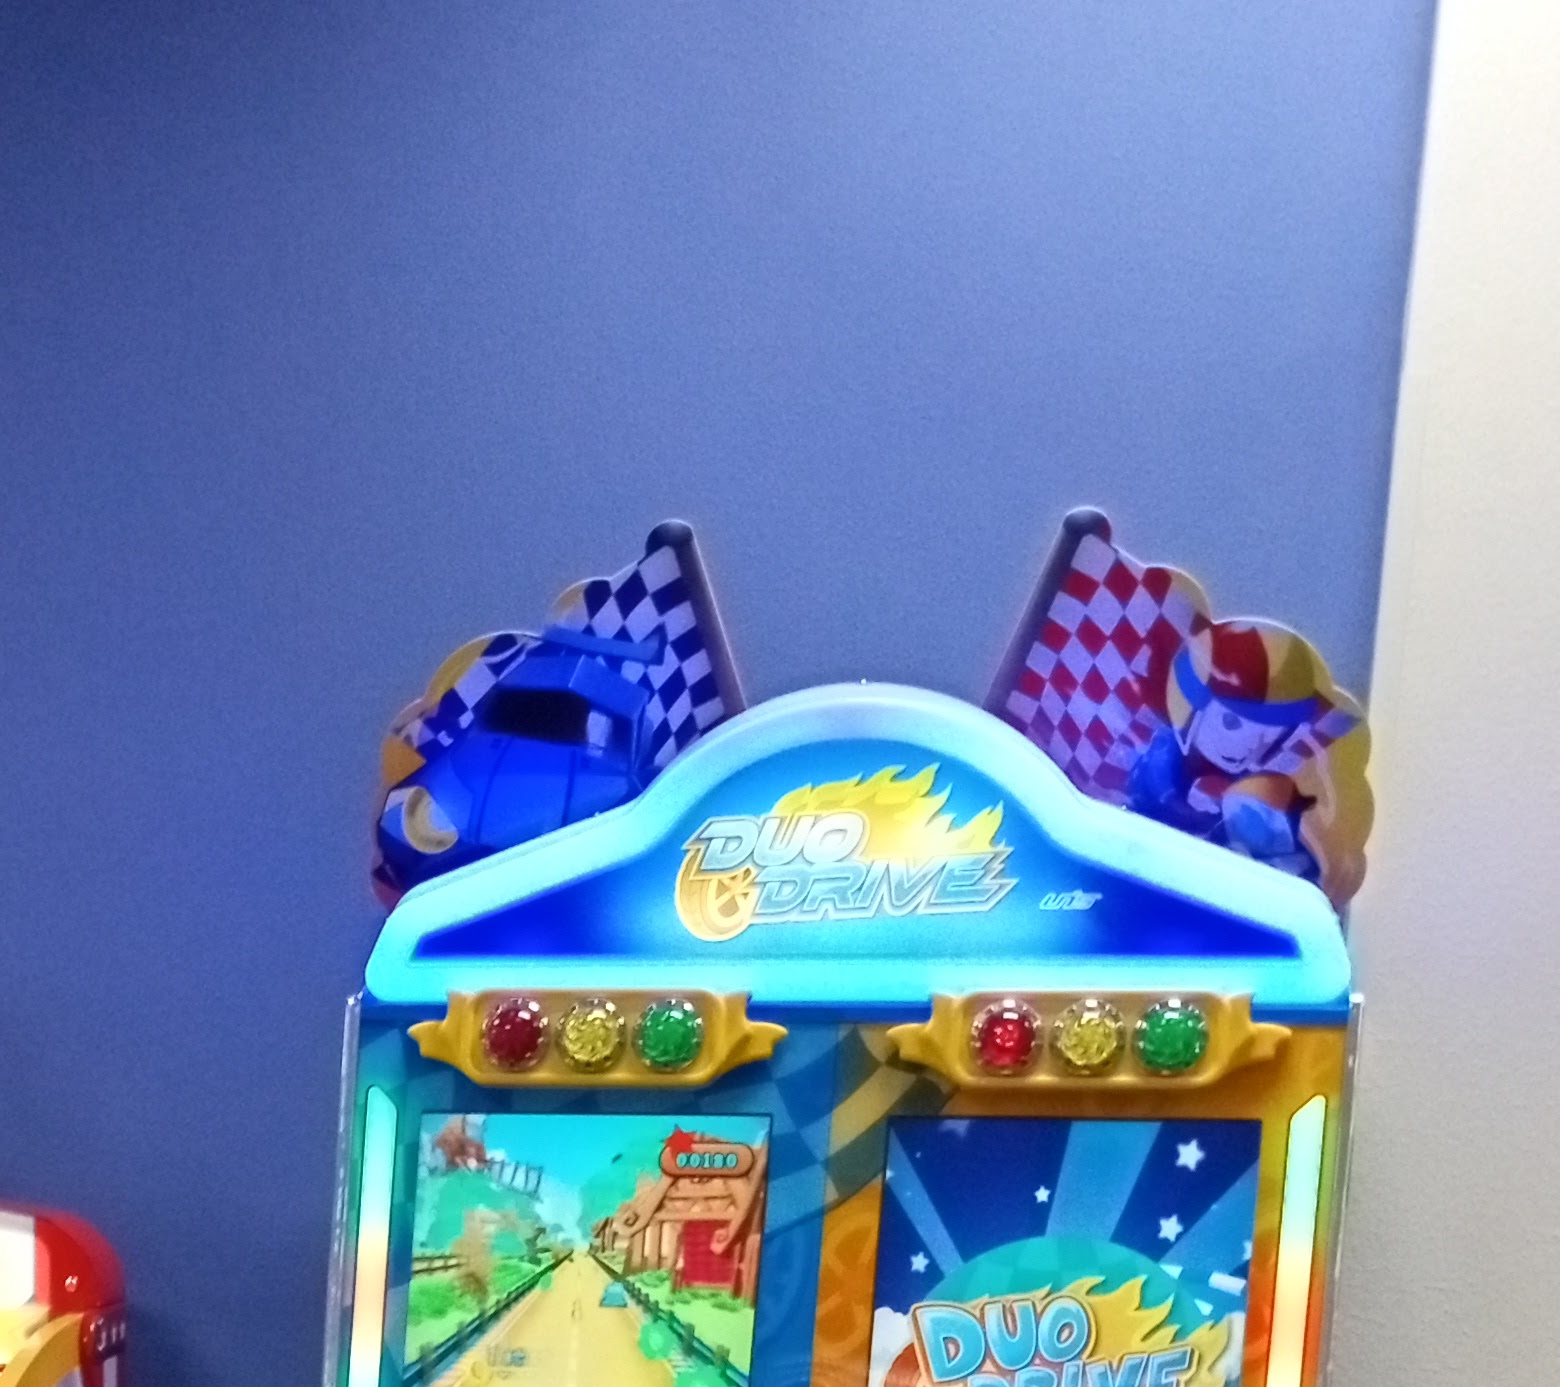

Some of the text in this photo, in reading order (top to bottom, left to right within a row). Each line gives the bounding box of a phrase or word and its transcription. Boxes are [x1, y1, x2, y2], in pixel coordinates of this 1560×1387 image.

[696, 811, 868, 870] DUO
[752, 849, 1010, 916] DRIVE
[913, 1297, 1090, 1382] DUO
